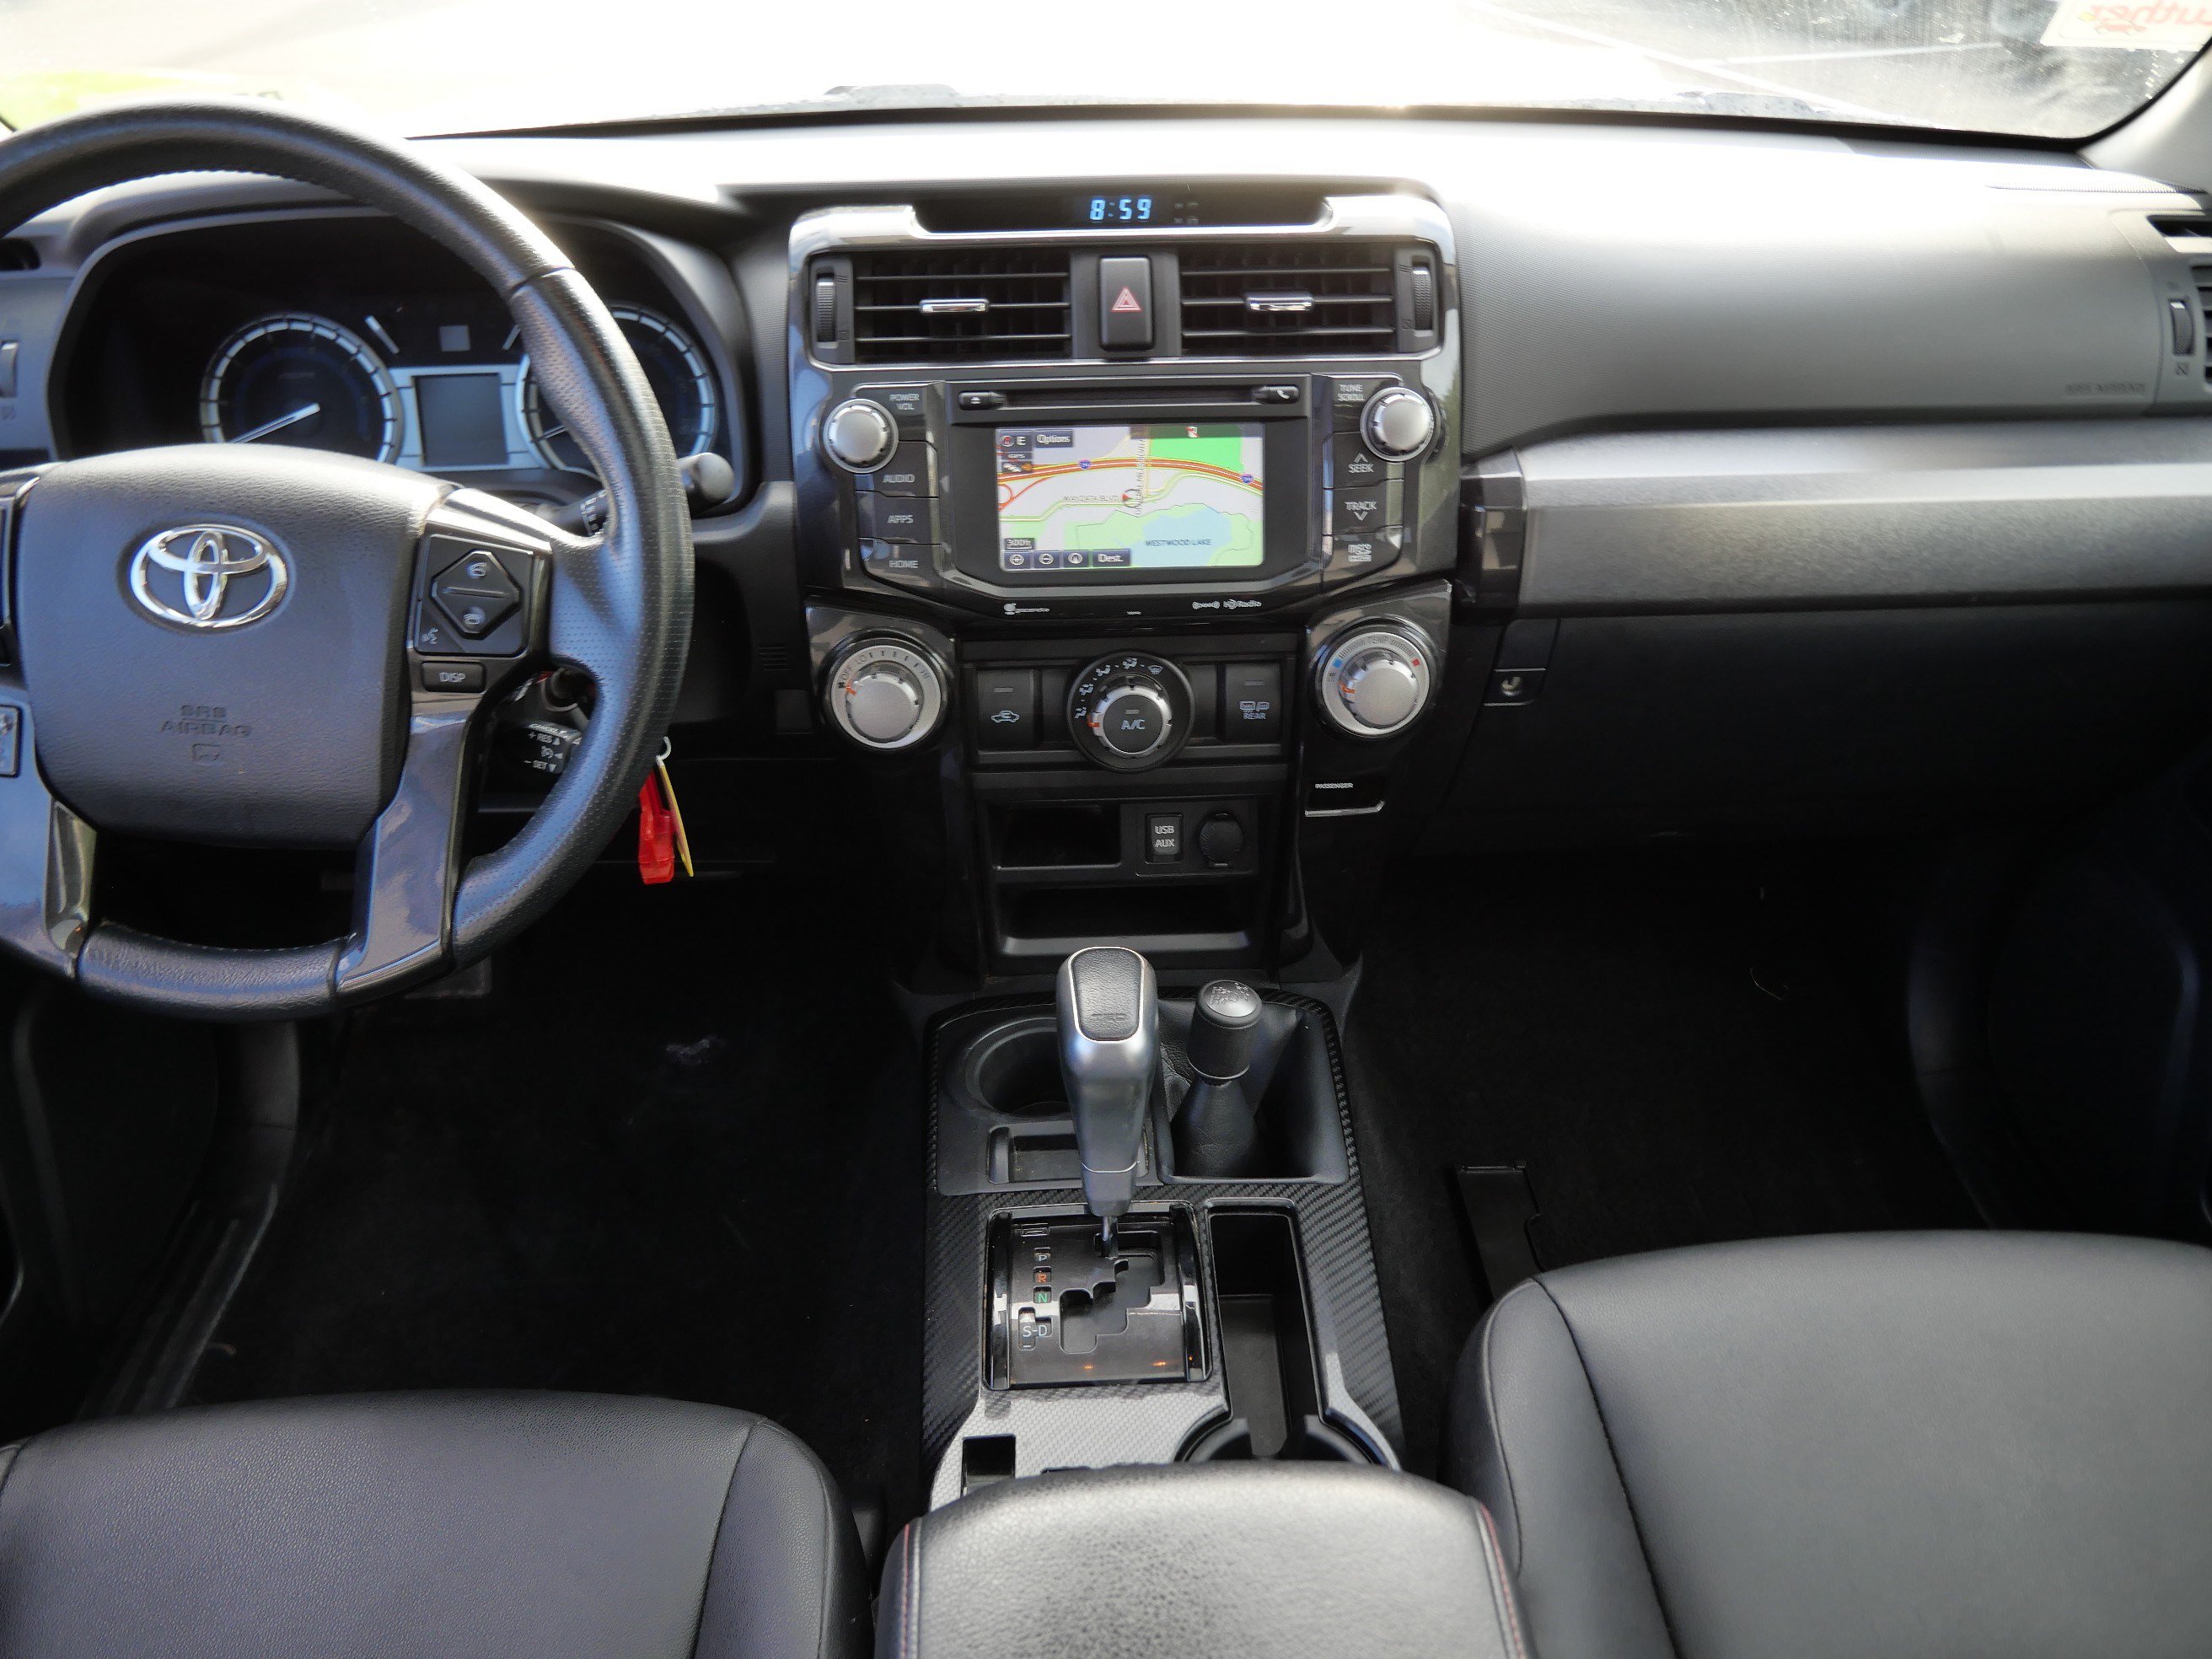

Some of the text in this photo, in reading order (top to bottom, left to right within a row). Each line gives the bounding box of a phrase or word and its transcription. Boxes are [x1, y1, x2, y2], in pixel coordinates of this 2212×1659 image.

[1089, 199, 1152, 220] 8:59
[1338, 384, 1364, 393] TUNE
[889, 394, 920, 402] POWER
[1337, 393, 1366, 402] SCROLL
[896, 403, 915, 411] VOL
[1016, 436, 1027, 446] E
[1036, 434, 1071, 445] Options
[1348, 463, 1375, 474] SEEK
[883, 473, 916, 484] AUDIO
[1345, 501, 1377, 512] TRACK
[887, 513, 915, 525] APPS
[1145, 538, 1214, 546] WESTWOOD LAKE
[889, 559, 919, 569] HOME
[842, 664, 854, 680] OFF
[438, 671, 467, 684] DISP
[1243, 711, 1266, 721] REAR
[1120, 719, 1146, 731] A/C
[1155, 825, 1174, 835] USB
[1155, 838, 1175, 848] AUX
[1038, 1254, 1048, 1263] P
[1038, 1275, 1047, 1283] R
[1037, 1292, 1049, 1303] N
